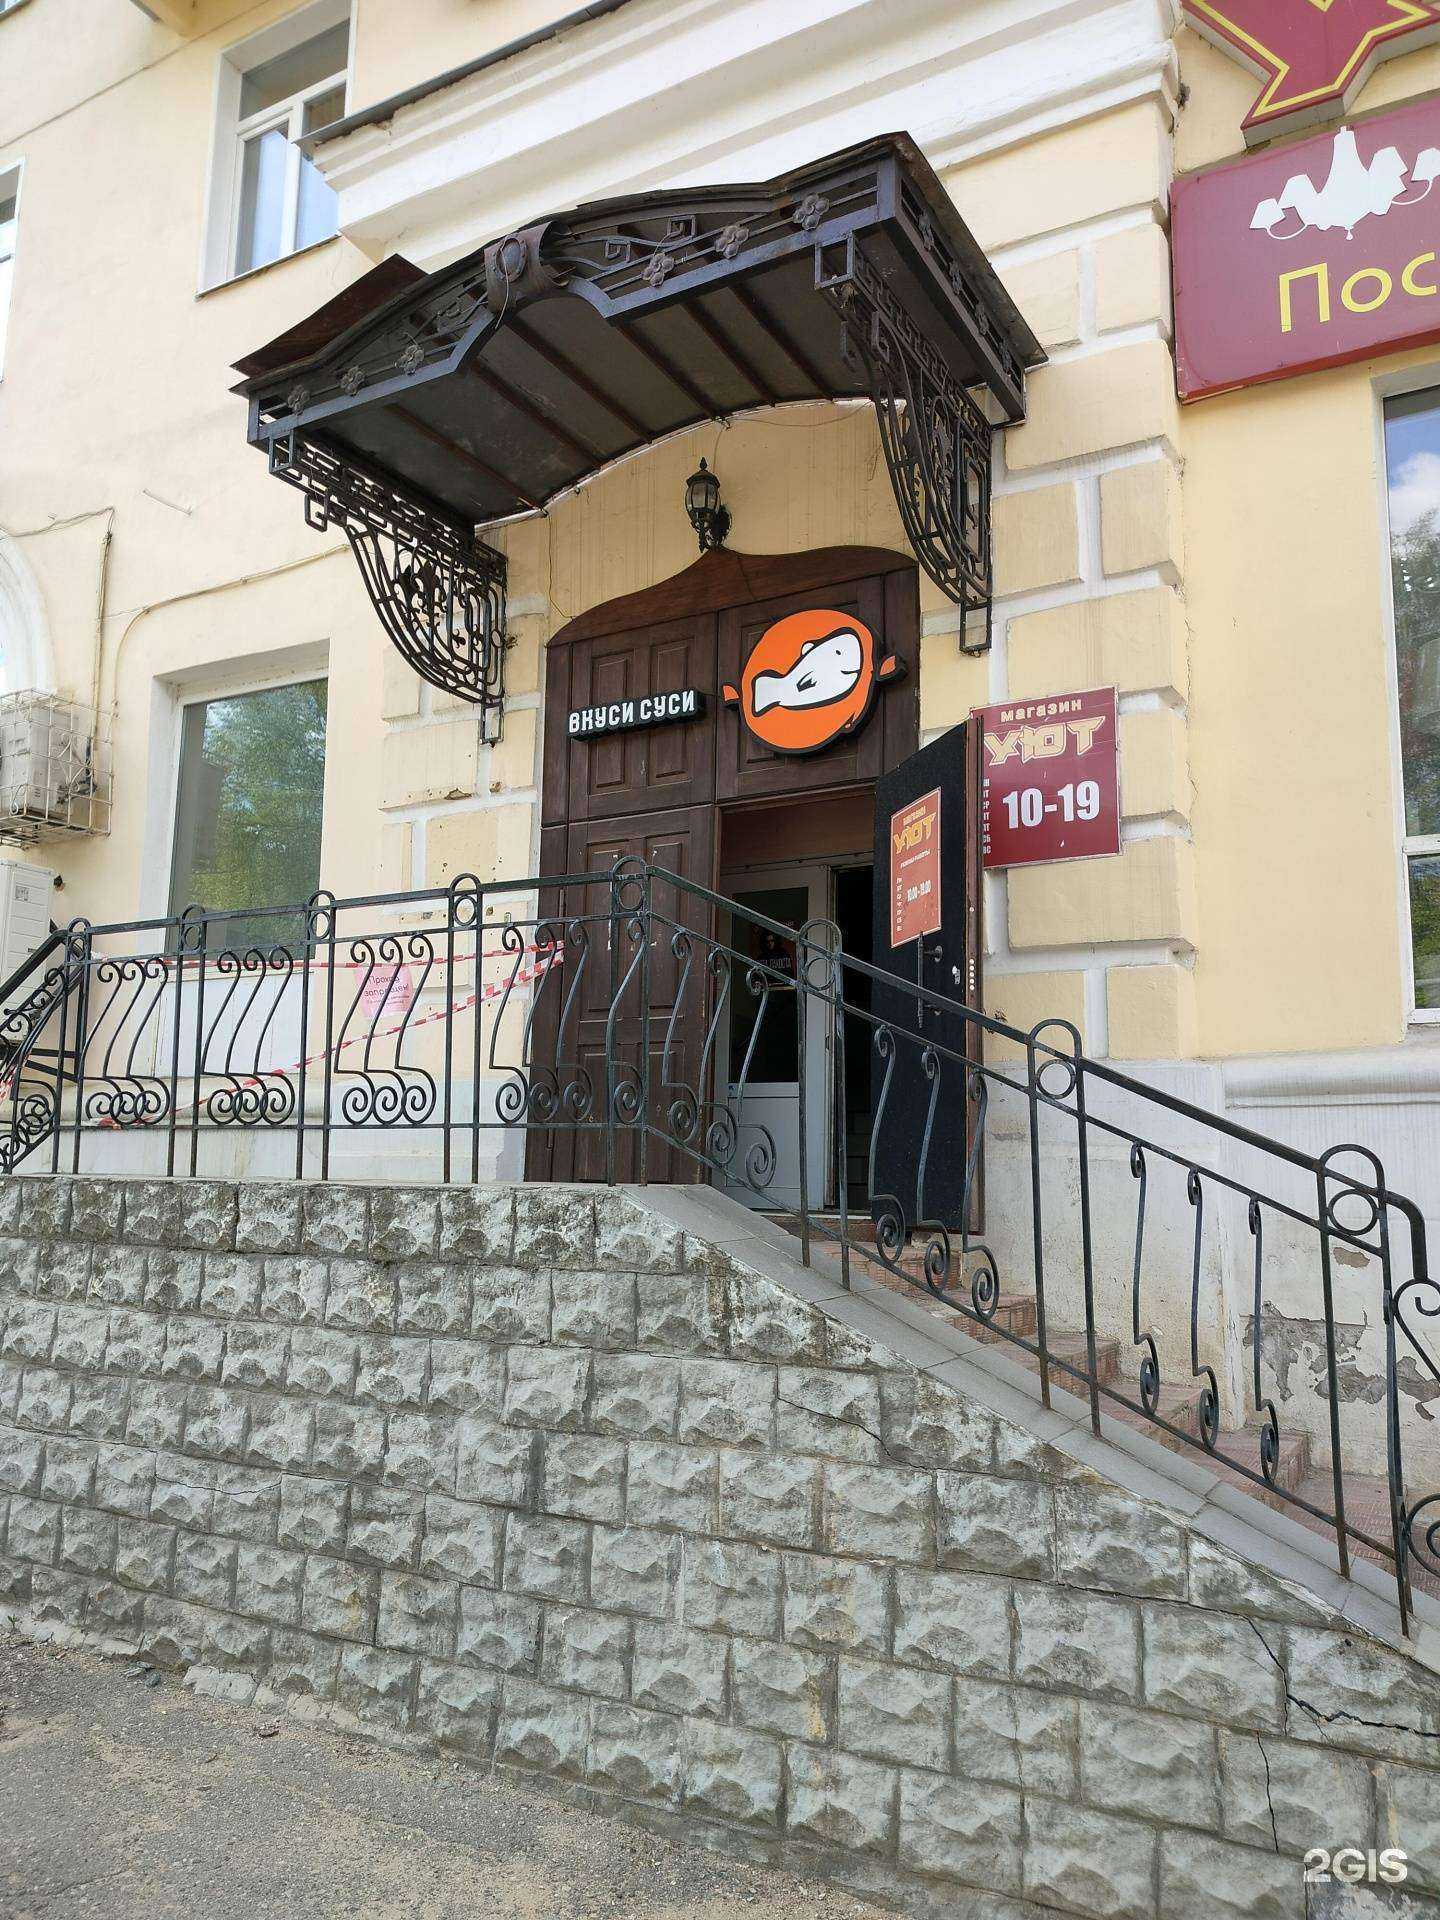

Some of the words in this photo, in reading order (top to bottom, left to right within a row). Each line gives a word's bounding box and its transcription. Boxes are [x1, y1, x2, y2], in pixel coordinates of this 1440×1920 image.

[568, 701, 634, 733] ВКУСИ
[640, 689, 695, 720] СУСИ
[1000, 698, 1082, 723] магазин
[984, 715, 1106, 766] УЮТ
[1002, 780, 1100, 829] 10-19
